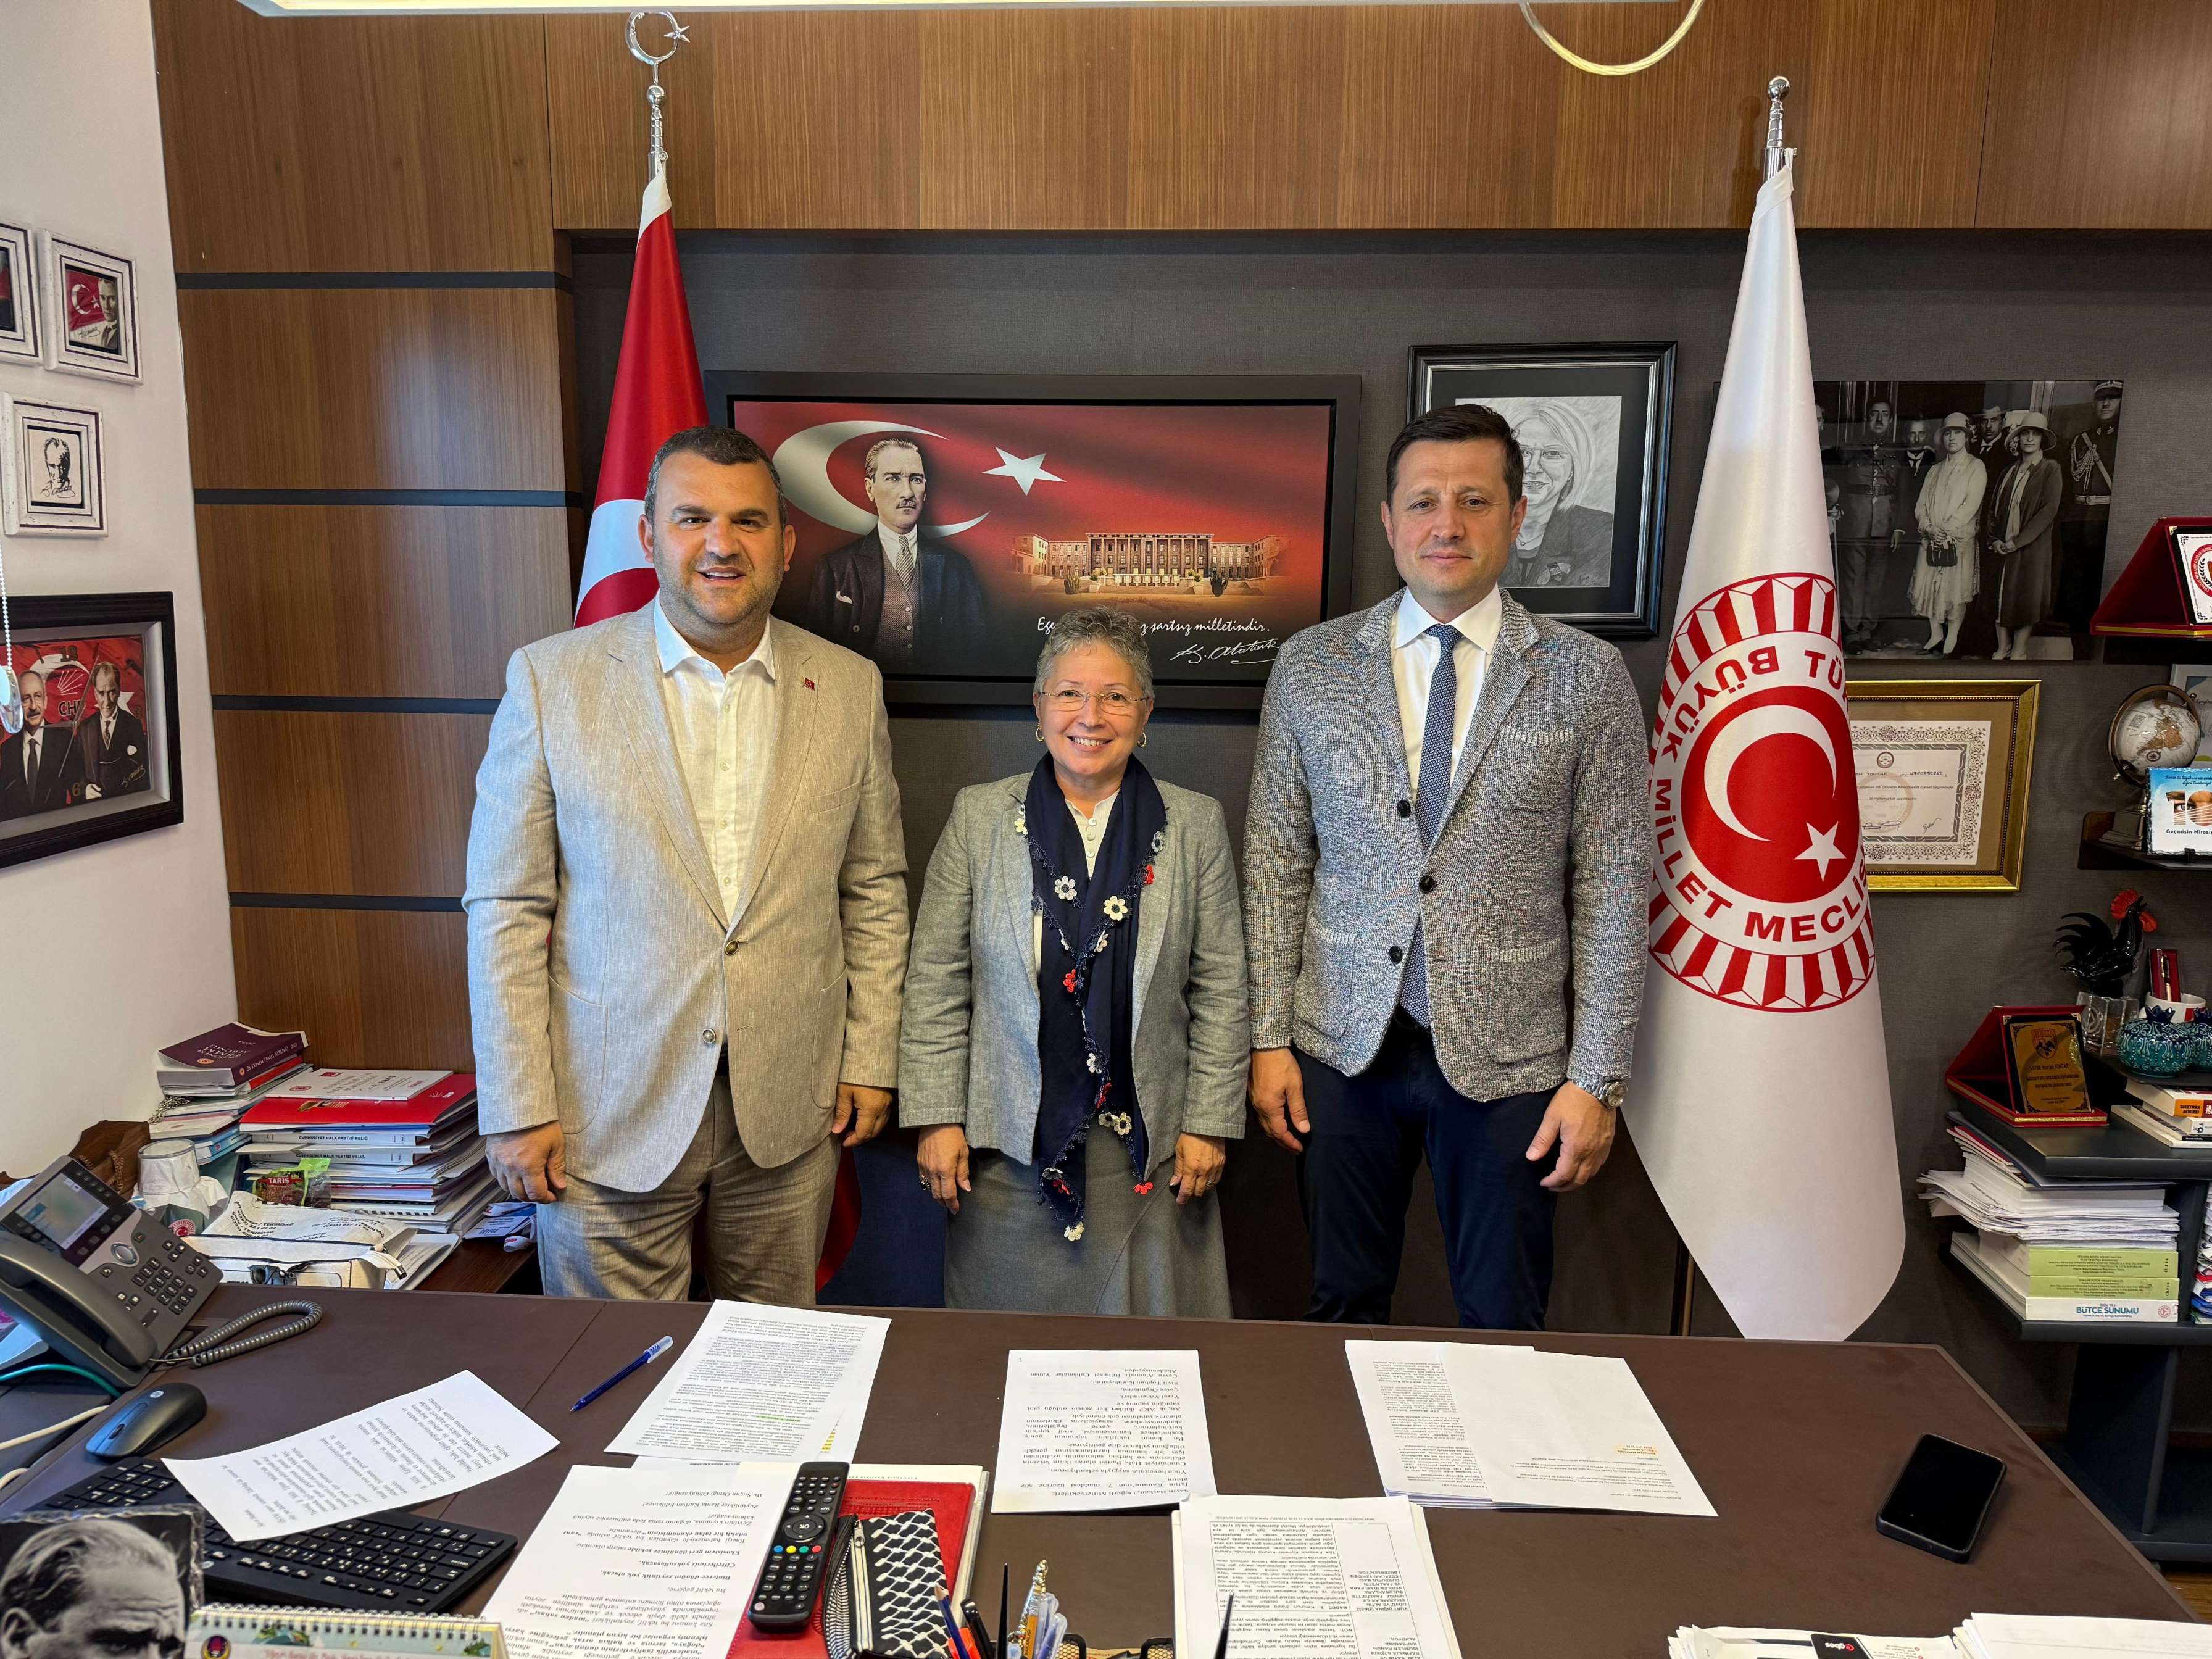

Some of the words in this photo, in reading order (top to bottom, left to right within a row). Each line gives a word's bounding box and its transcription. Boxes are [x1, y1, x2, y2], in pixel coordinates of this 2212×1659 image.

[1194, 617, 1270, 632] milletindir.
[1661, 646, 1779, 763] BÜYÜK
[1803, 649, 1847, 699] TÜ
[1655, 779, 1733, 919] MİLLET
[1744, 849, 1866, 942] MECLİS
[2076, 1307, 2102, 1315] BÜTÇE
